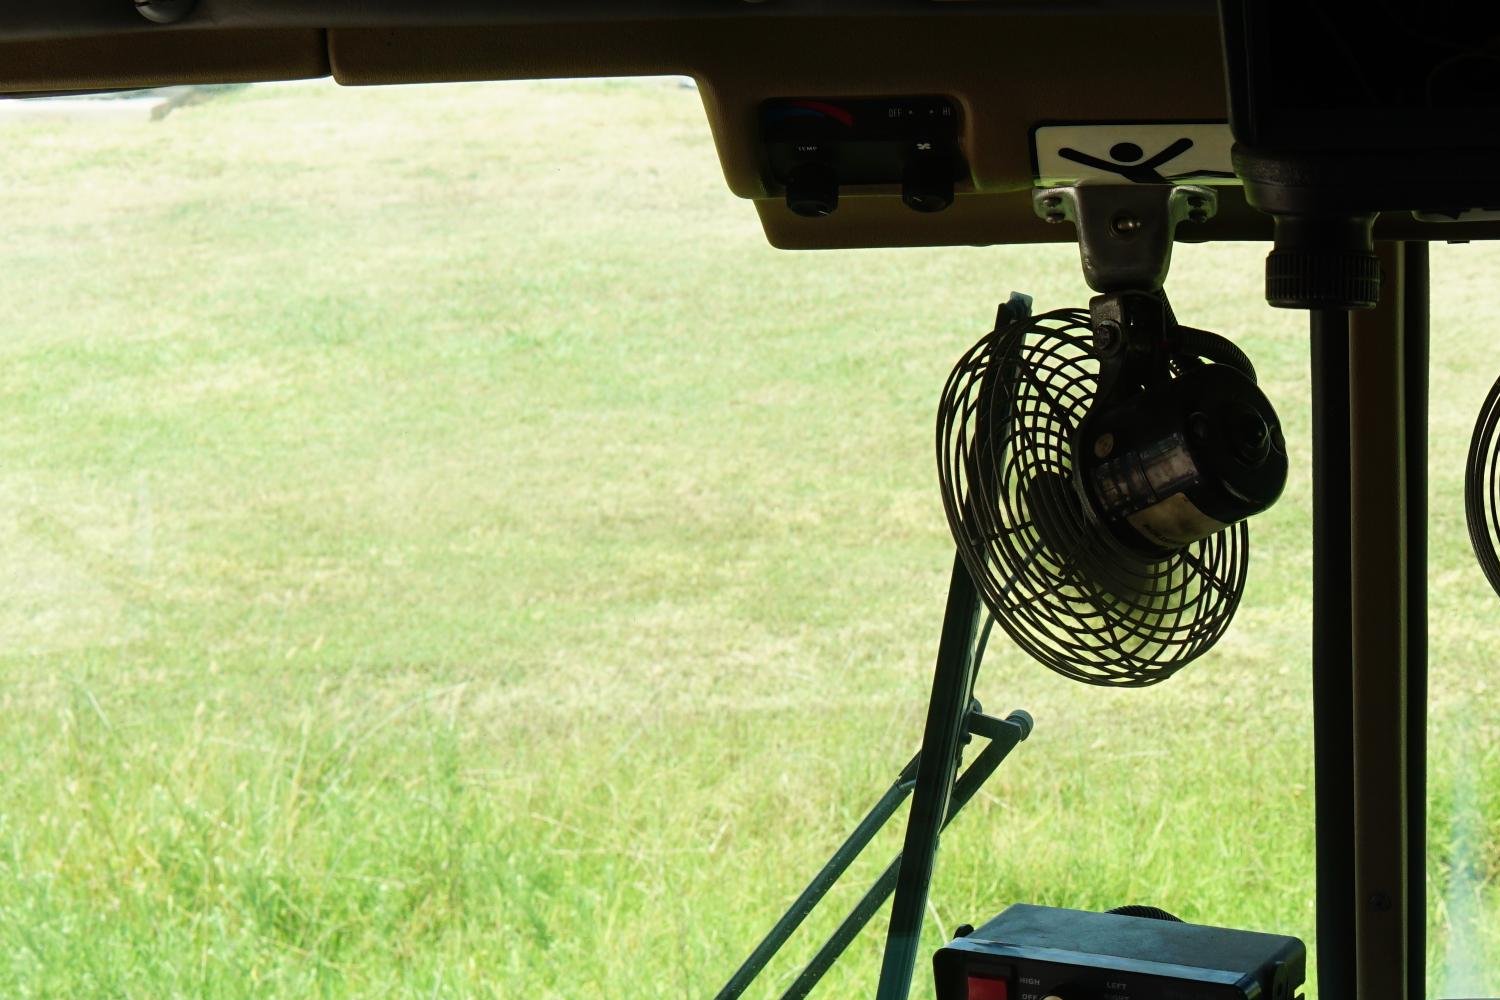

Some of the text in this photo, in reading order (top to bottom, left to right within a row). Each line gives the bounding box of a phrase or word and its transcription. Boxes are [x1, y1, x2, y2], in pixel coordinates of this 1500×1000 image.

[1020, 977, 1040, 986] HIGH
[1106, 982, 1126, 990] LEFT
[1022, 993, 1038, 1000] OFF
